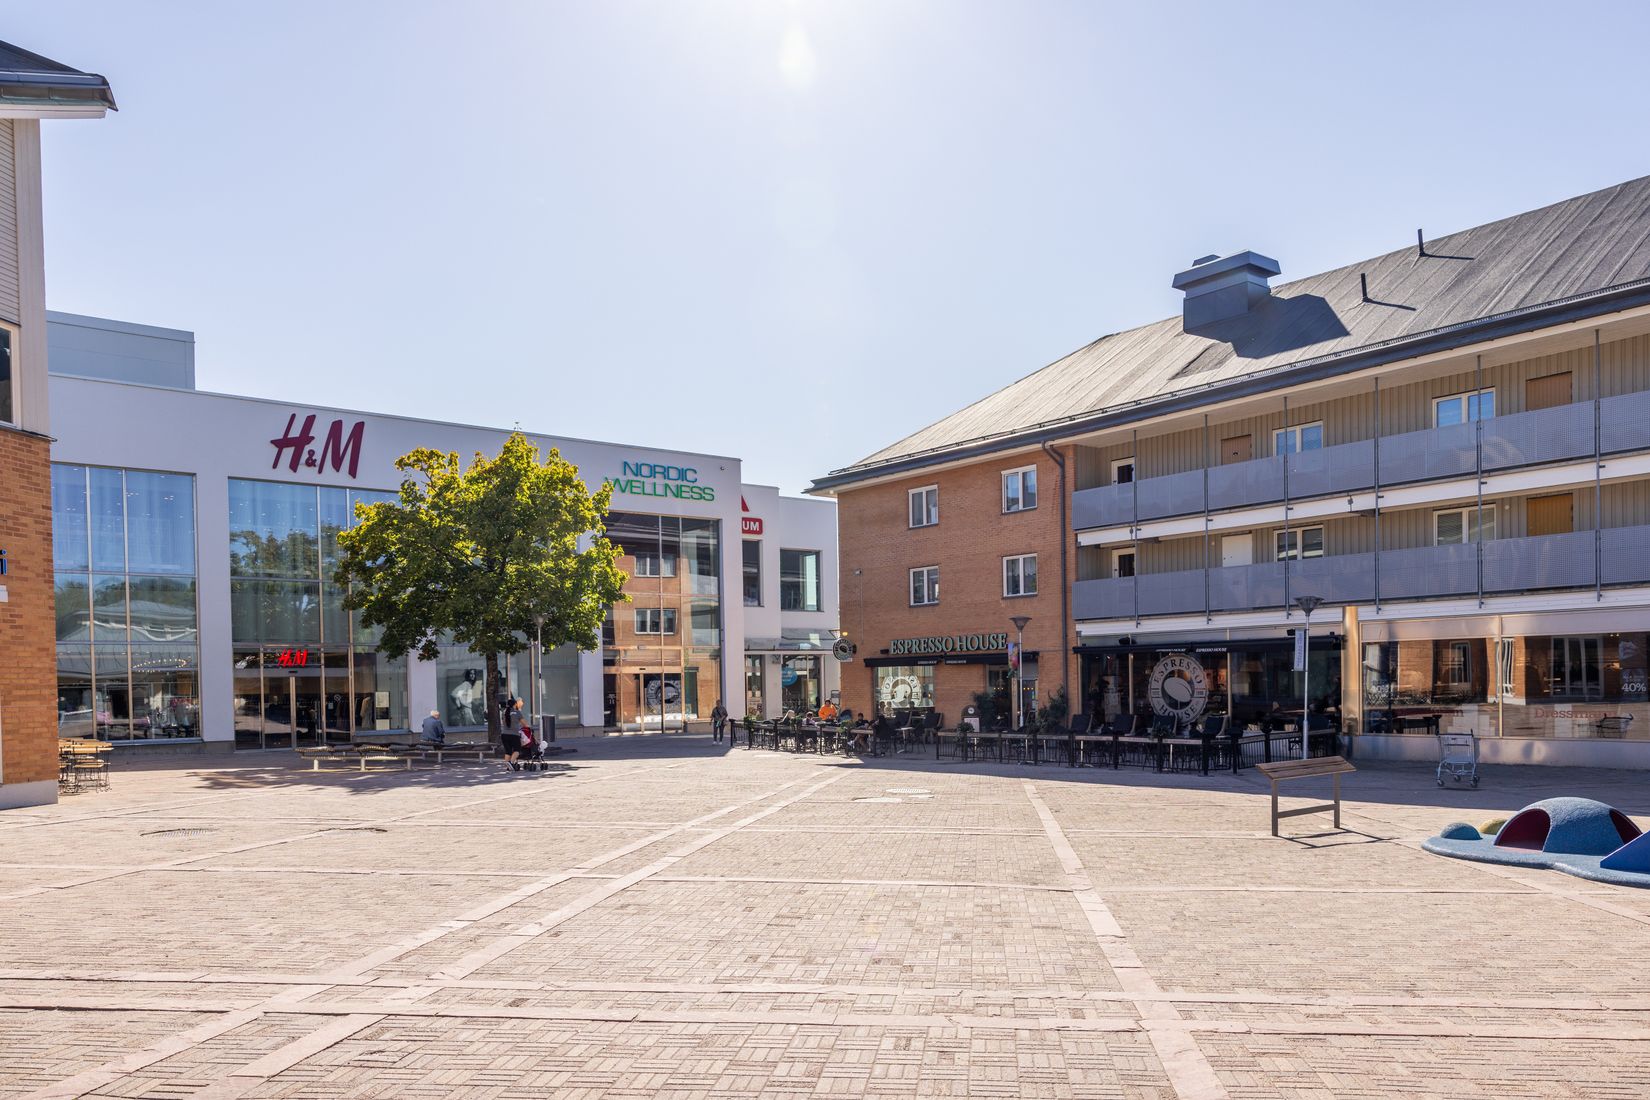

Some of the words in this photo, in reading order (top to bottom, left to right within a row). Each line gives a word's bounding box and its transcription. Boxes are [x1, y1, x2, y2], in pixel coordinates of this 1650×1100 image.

[270, 413, 365, 479] H&M
[623, 461, 698, 483] NORDIC
[605, 477, 715, 501] WELLNESS
[890, 636, 953, 655] ESPRESSO
[957, 633, 1008, 651] HOUSE
[277, 648, 309, 668] H&M
[1153, 658, 1203, 684] ESPRESSO
[1621, 682, 1647, 692] 40%
